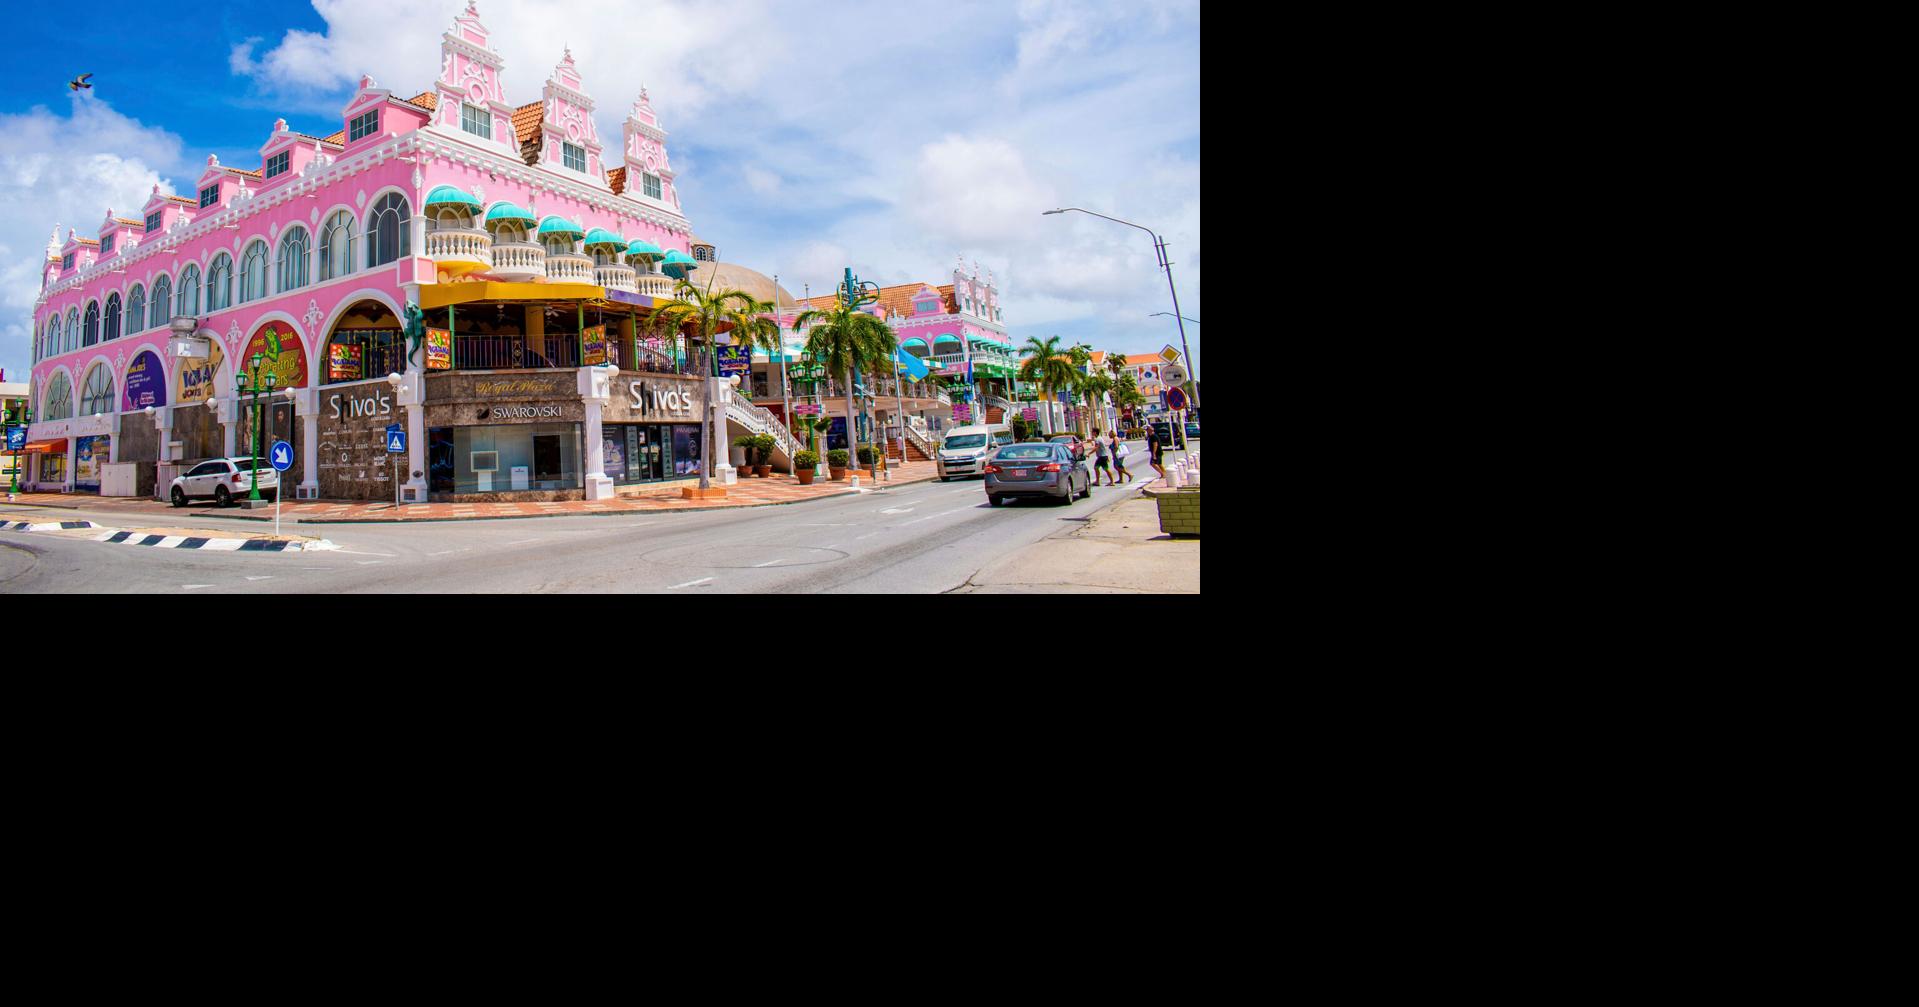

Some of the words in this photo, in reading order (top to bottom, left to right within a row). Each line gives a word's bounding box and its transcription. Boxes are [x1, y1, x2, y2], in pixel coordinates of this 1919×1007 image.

[477, 380, 516, 396] Royal
[519, 379, 553, 393] Plaza
[629, 381, 692, 416] Shiva's
[330, 390, 391, 424] Shiva's
[493, 406, 562, 419] SWAROVSKI
